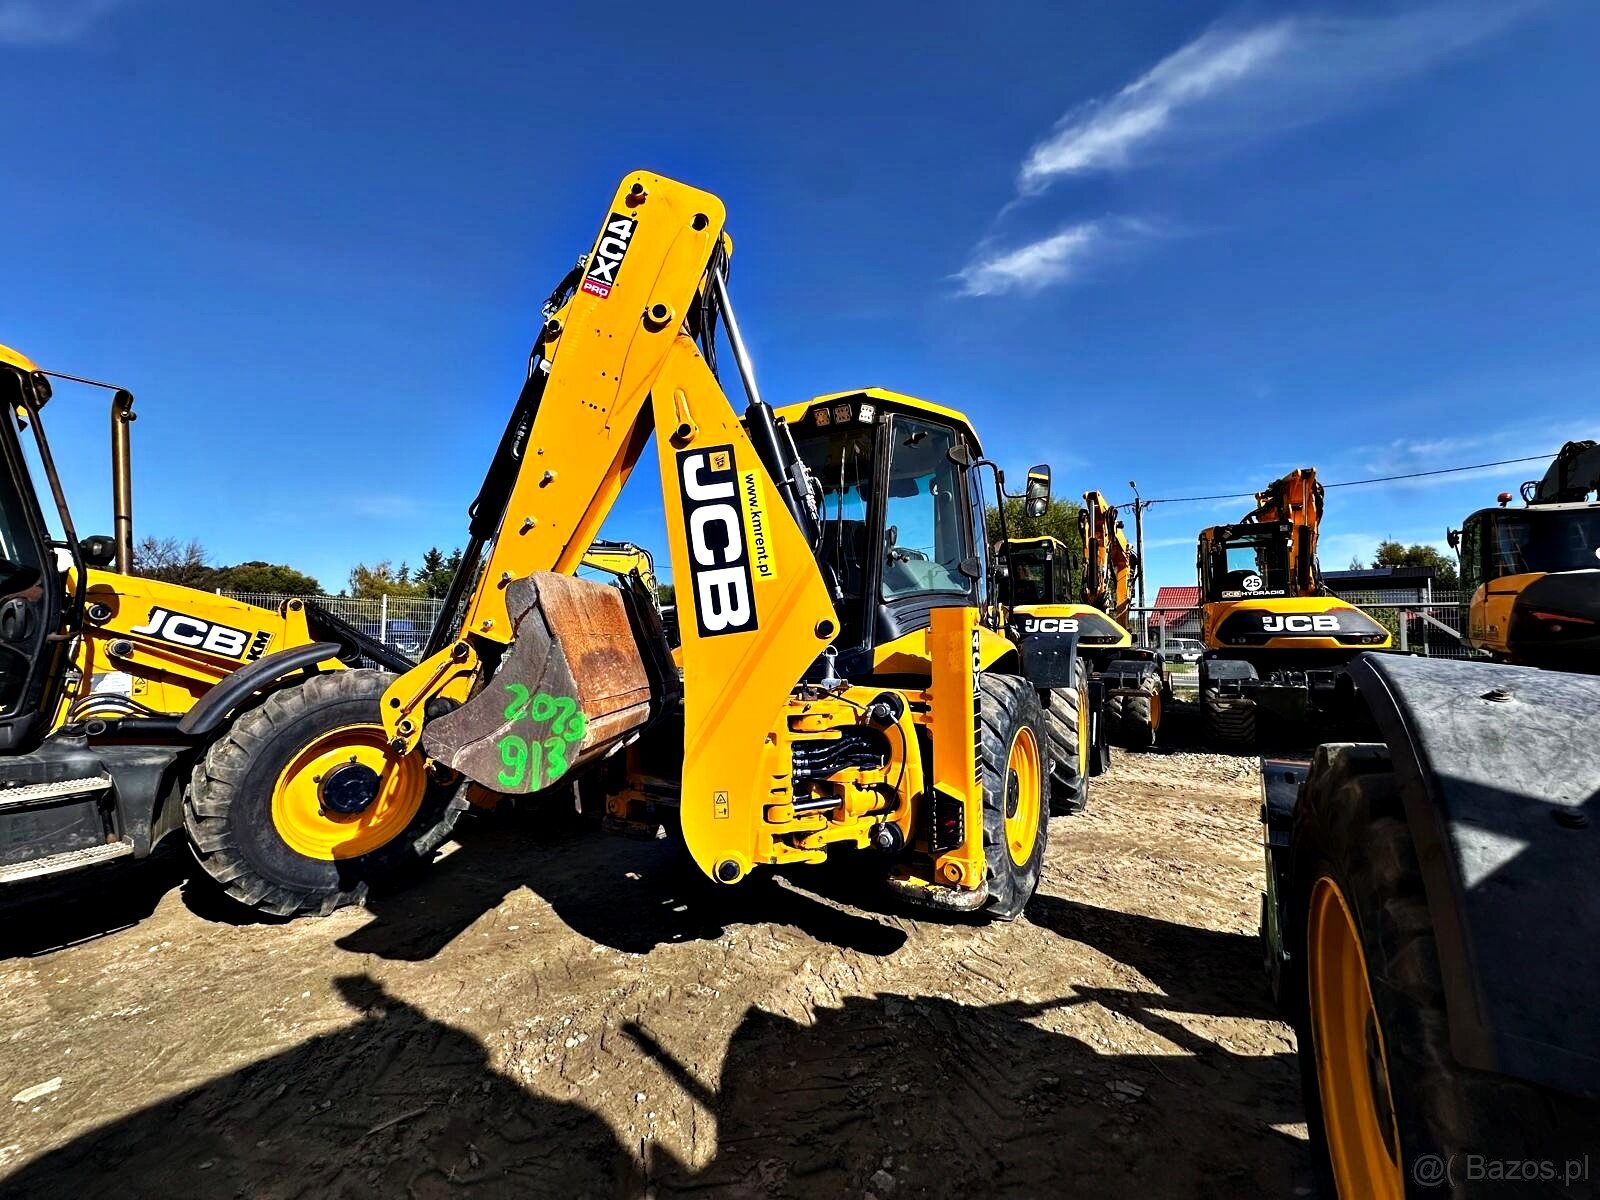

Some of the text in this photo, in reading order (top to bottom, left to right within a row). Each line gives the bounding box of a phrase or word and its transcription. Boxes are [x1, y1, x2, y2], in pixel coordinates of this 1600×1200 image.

[588, 219, 632, 283] 4CX
[583, 282, 609, 297] PRO
[683, 454, 750, 631] JCB
[745, 473, 772, 577] www.kmrent.pl
[1245, 578, 1260, 588] 25
[131, 609, 247, 656] JCB
[1024, 619, 1079, 633] JCB
[1262, 615, 1341, 632] JCB
[972, 631, 981, 692] 4CX
[498, 735, 568, 792] 913
